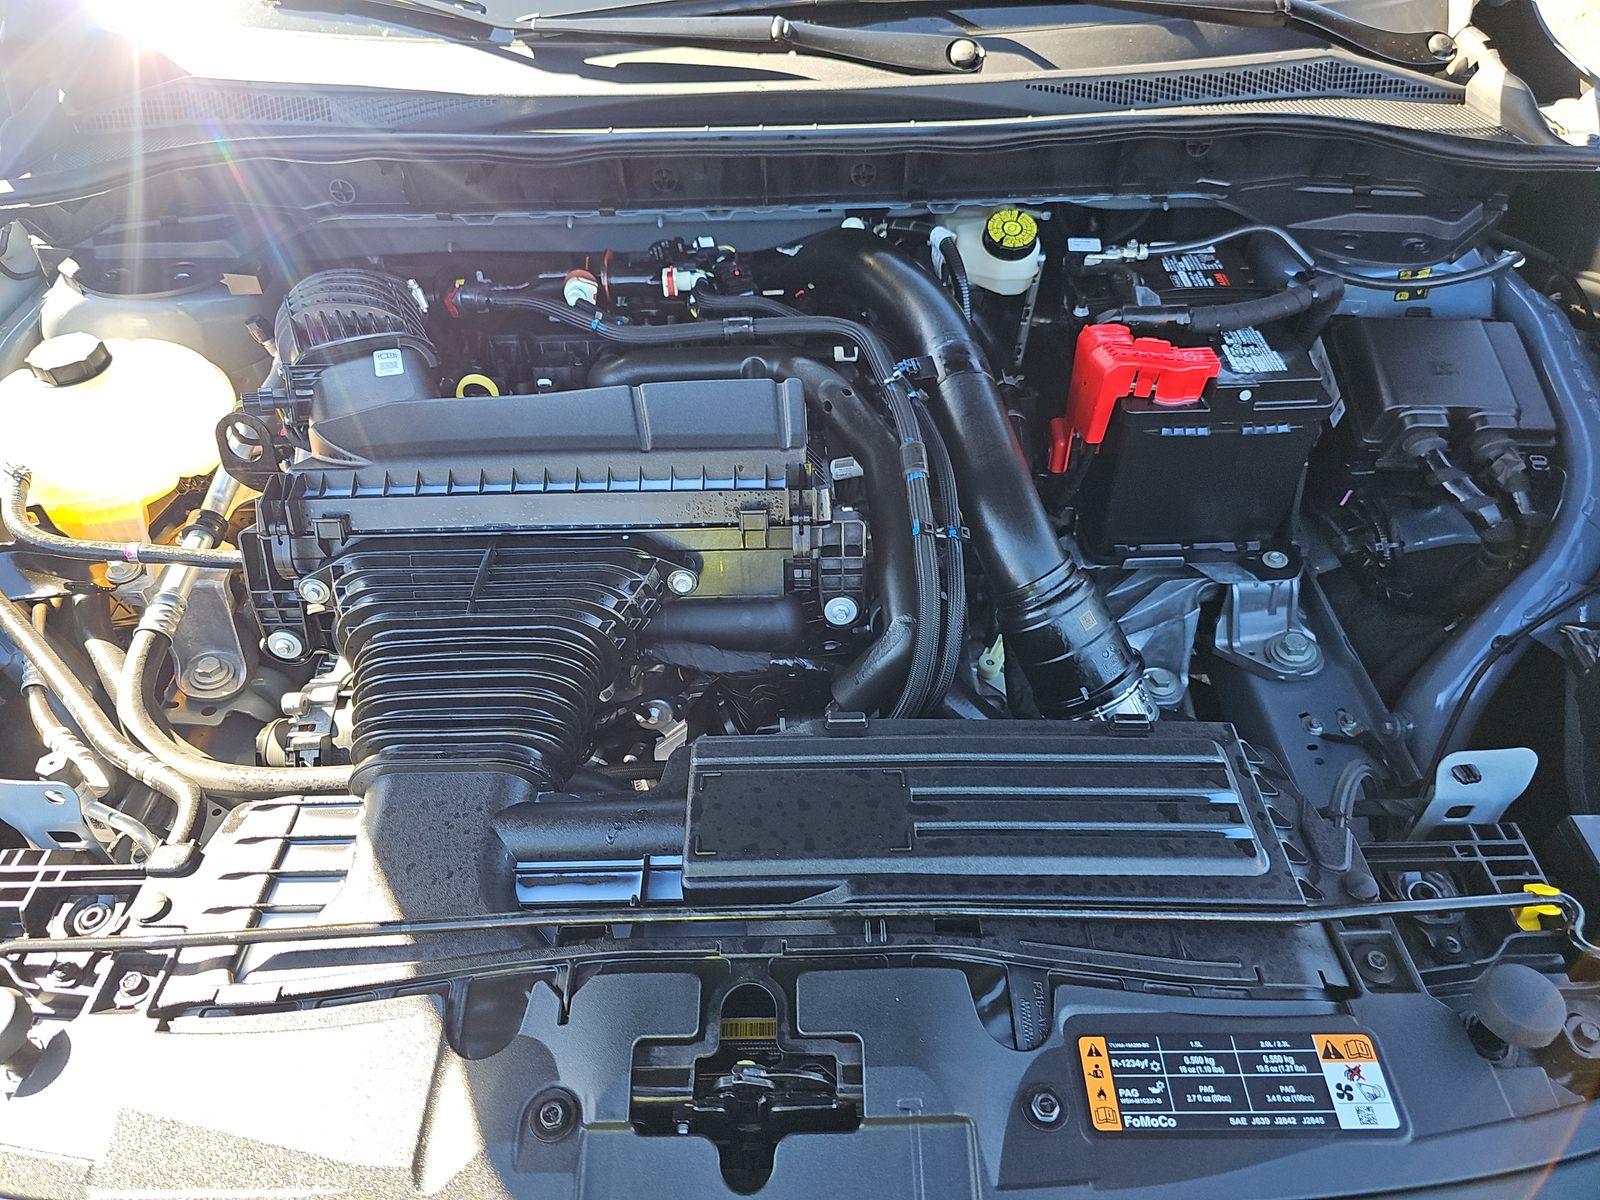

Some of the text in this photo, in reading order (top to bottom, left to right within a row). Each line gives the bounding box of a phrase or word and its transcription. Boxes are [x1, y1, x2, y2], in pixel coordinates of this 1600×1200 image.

[1111, 1059, 1149, 1069] R-1234yf
[1183, 1056, 1215, 1066] 0.500 kg
[1262, 1055, 1295, 1065] 0.550 kg
[1212, 1065, 1225, 1074] lbs)
[1294, 1064, 1307, 1073] lbs)
[1118, 1088, 1139, 1098] PAG
[1198, 1085, 1215, 1093] PAG
[1279, 1085, 1296, 1093] PAG
[1123, 1115, 1177, 1128] FoMoCo
[1229, 1117, 1248, 1125] SAE
